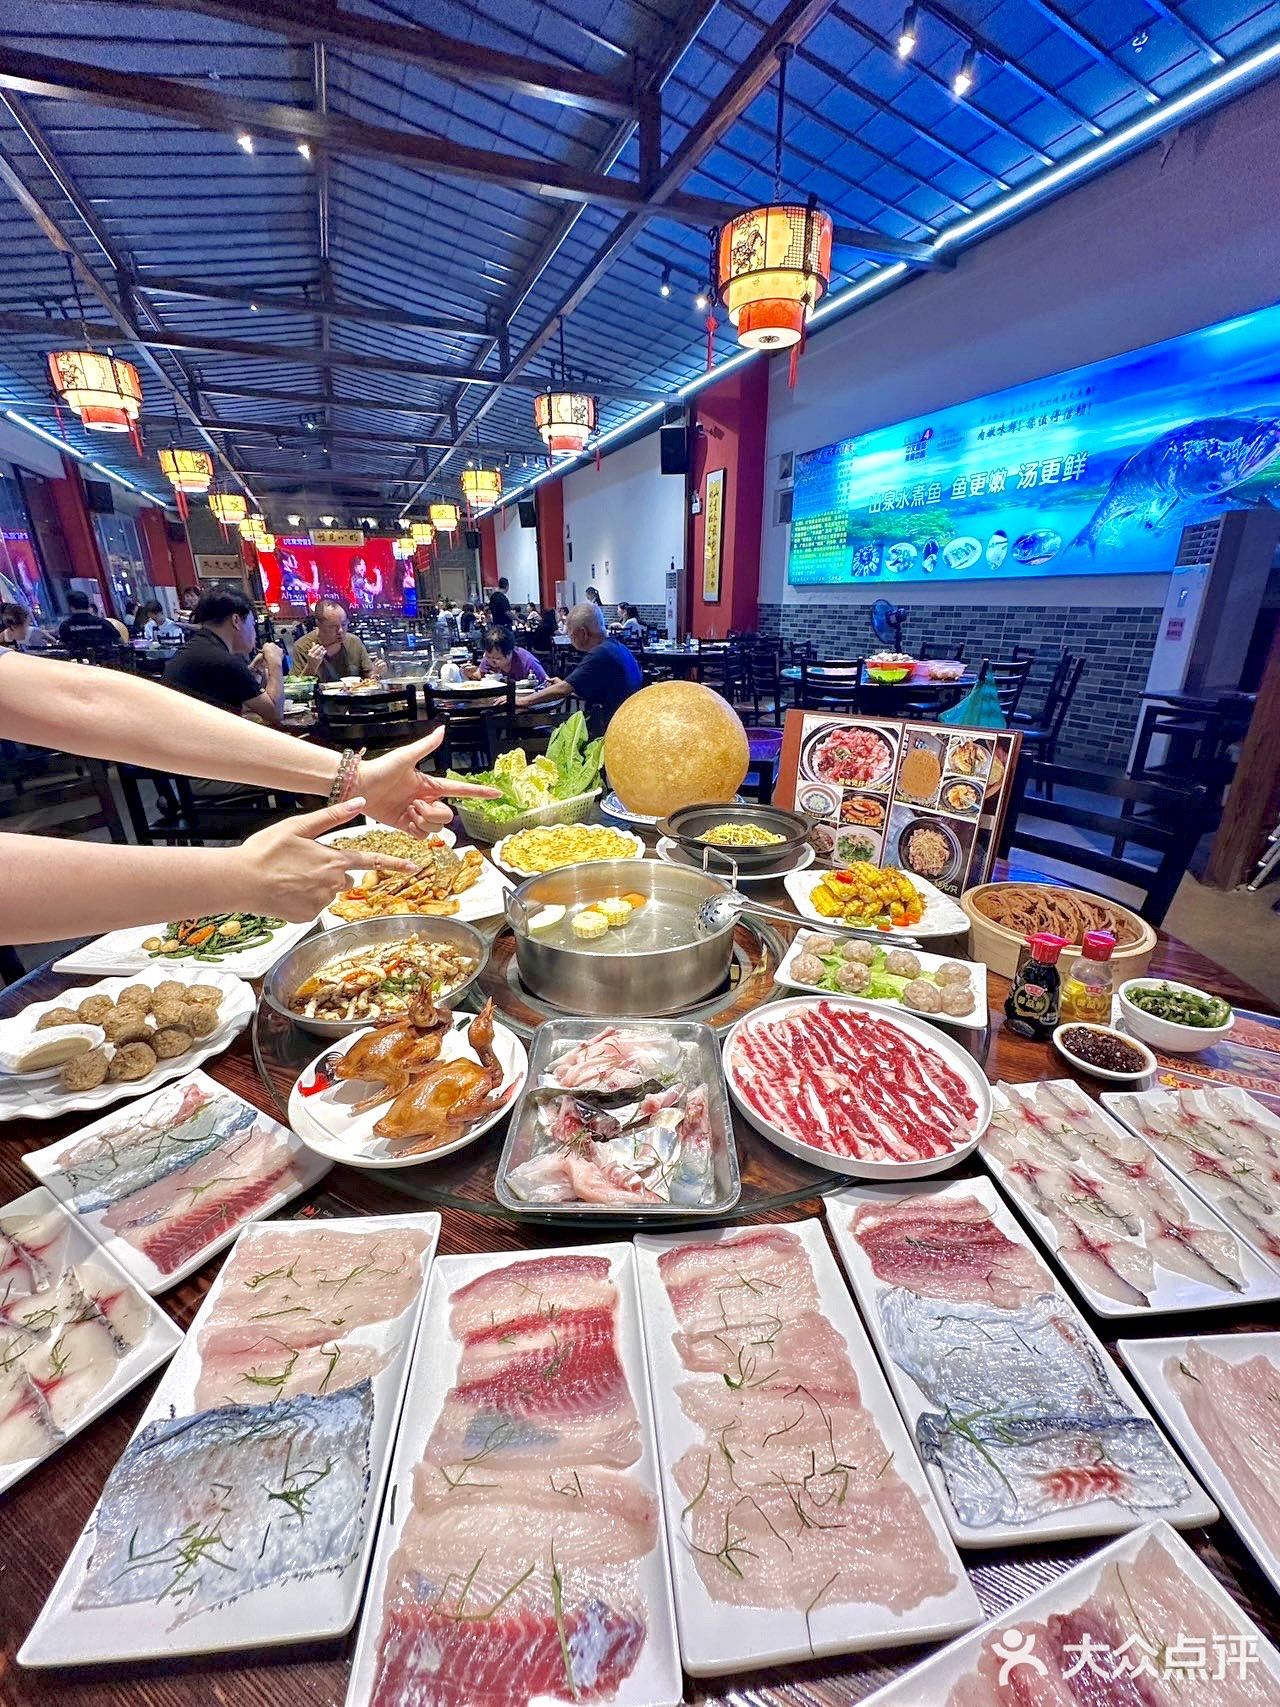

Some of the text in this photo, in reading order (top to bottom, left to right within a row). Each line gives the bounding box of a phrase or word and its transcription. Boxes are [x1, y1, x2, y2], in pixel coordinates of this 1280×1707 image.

[868, 482, 943, 514] 山泉水煮鱼
[950, 468, 1008, 501] 鱼更嫩
[1016, 451, 1089, 489] 汤更鲜
